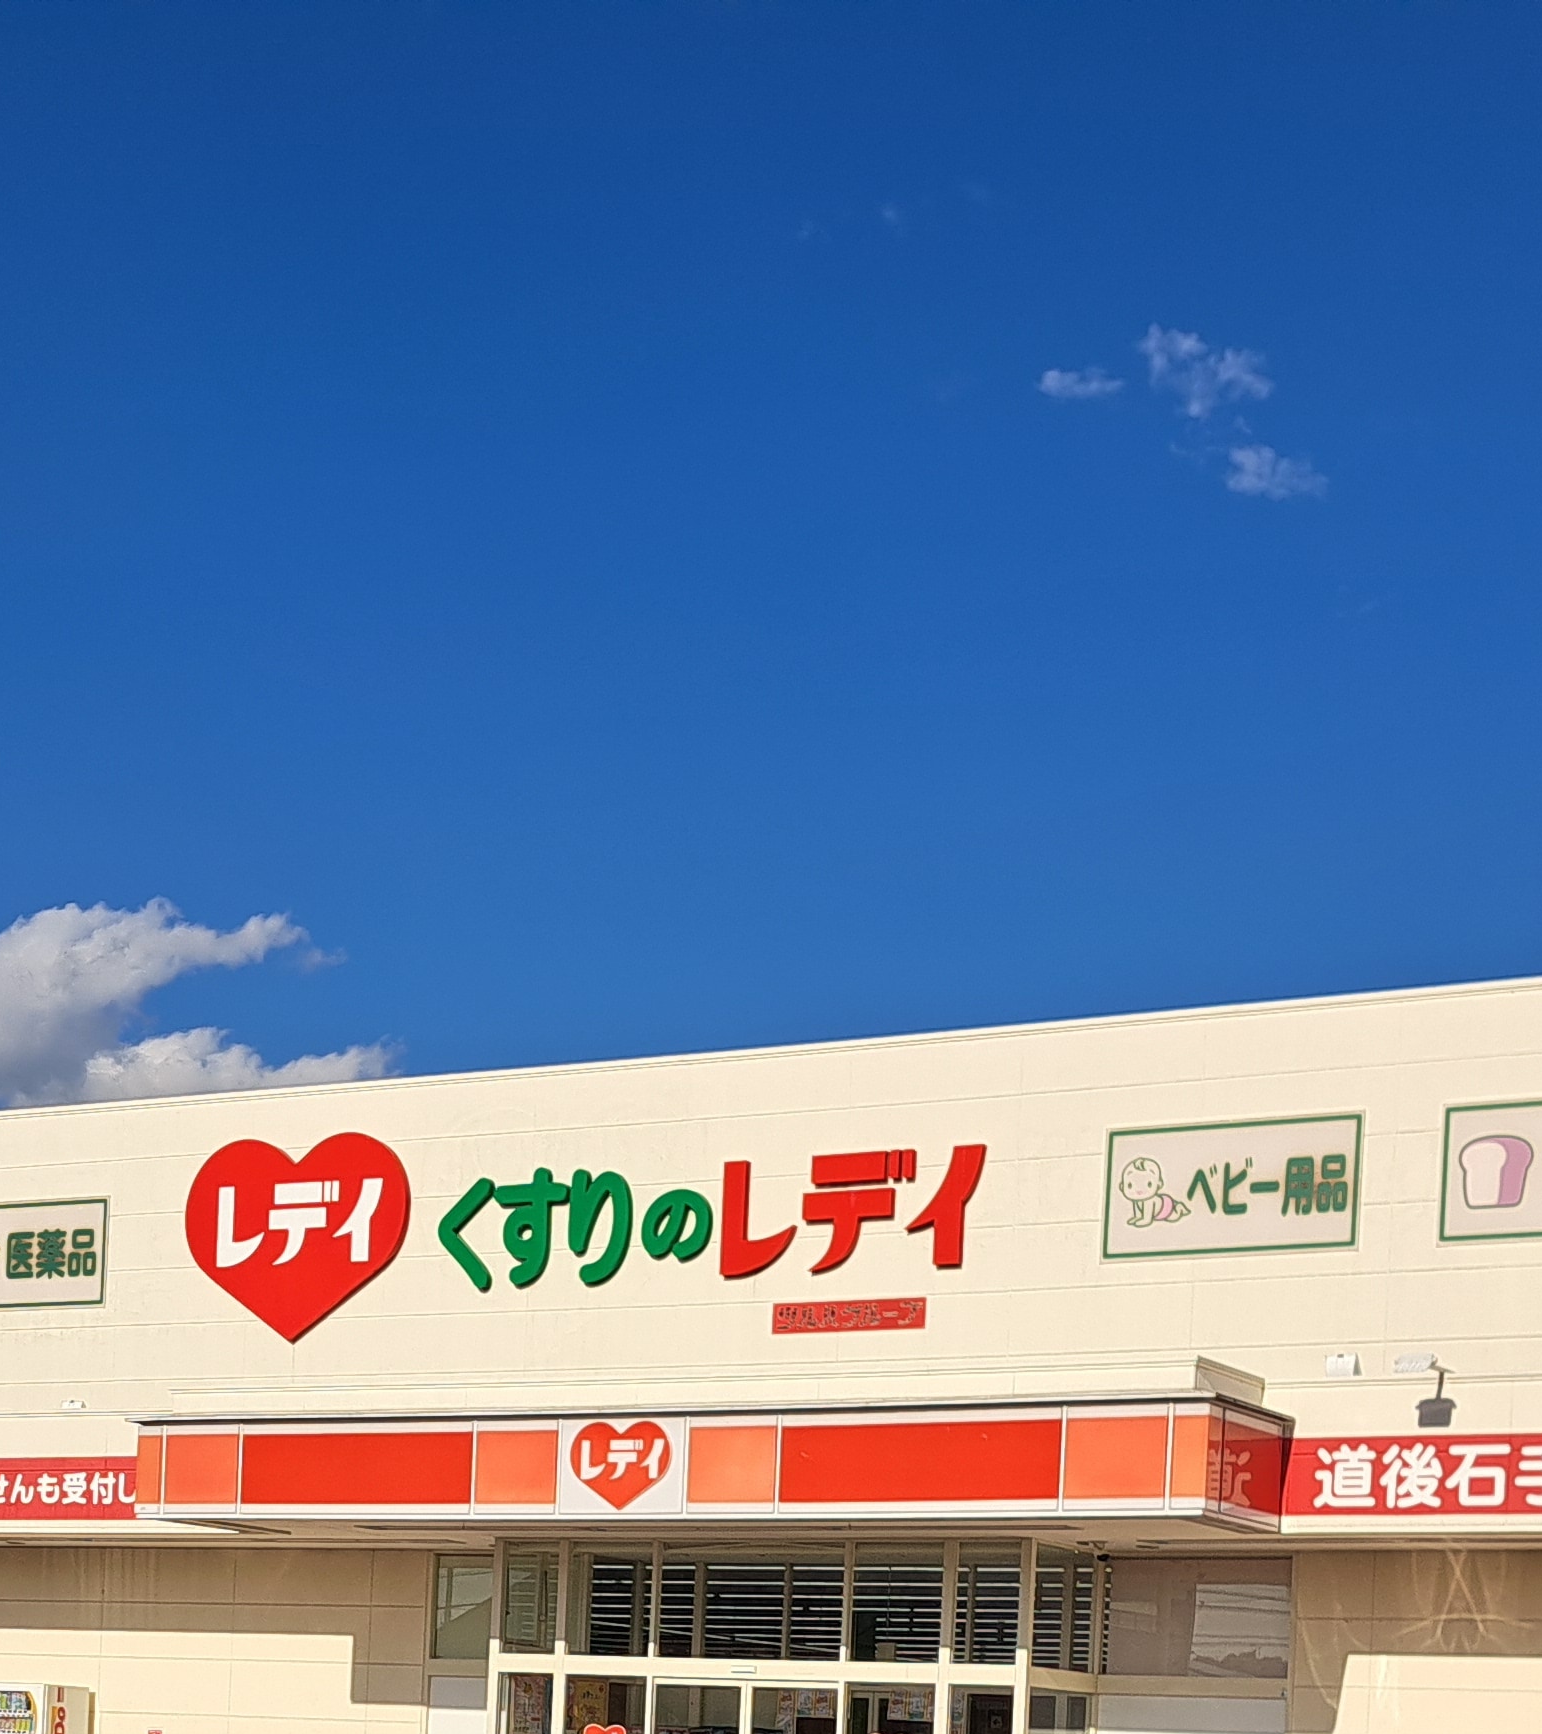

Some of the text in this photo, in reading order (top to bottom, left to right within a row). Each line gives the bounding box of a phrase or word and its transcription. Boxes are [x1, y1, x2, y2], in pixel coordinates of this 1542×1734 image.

[1186, 1153, 1349, 1217] ベビー用品
[216, 1176, 383, 1268] レディ
[436, 1144, 987, 1292] くすりのレディ
[5, 1228, 97, 1281] 医薬品
[578, 1438, 665, 1481] レディ
